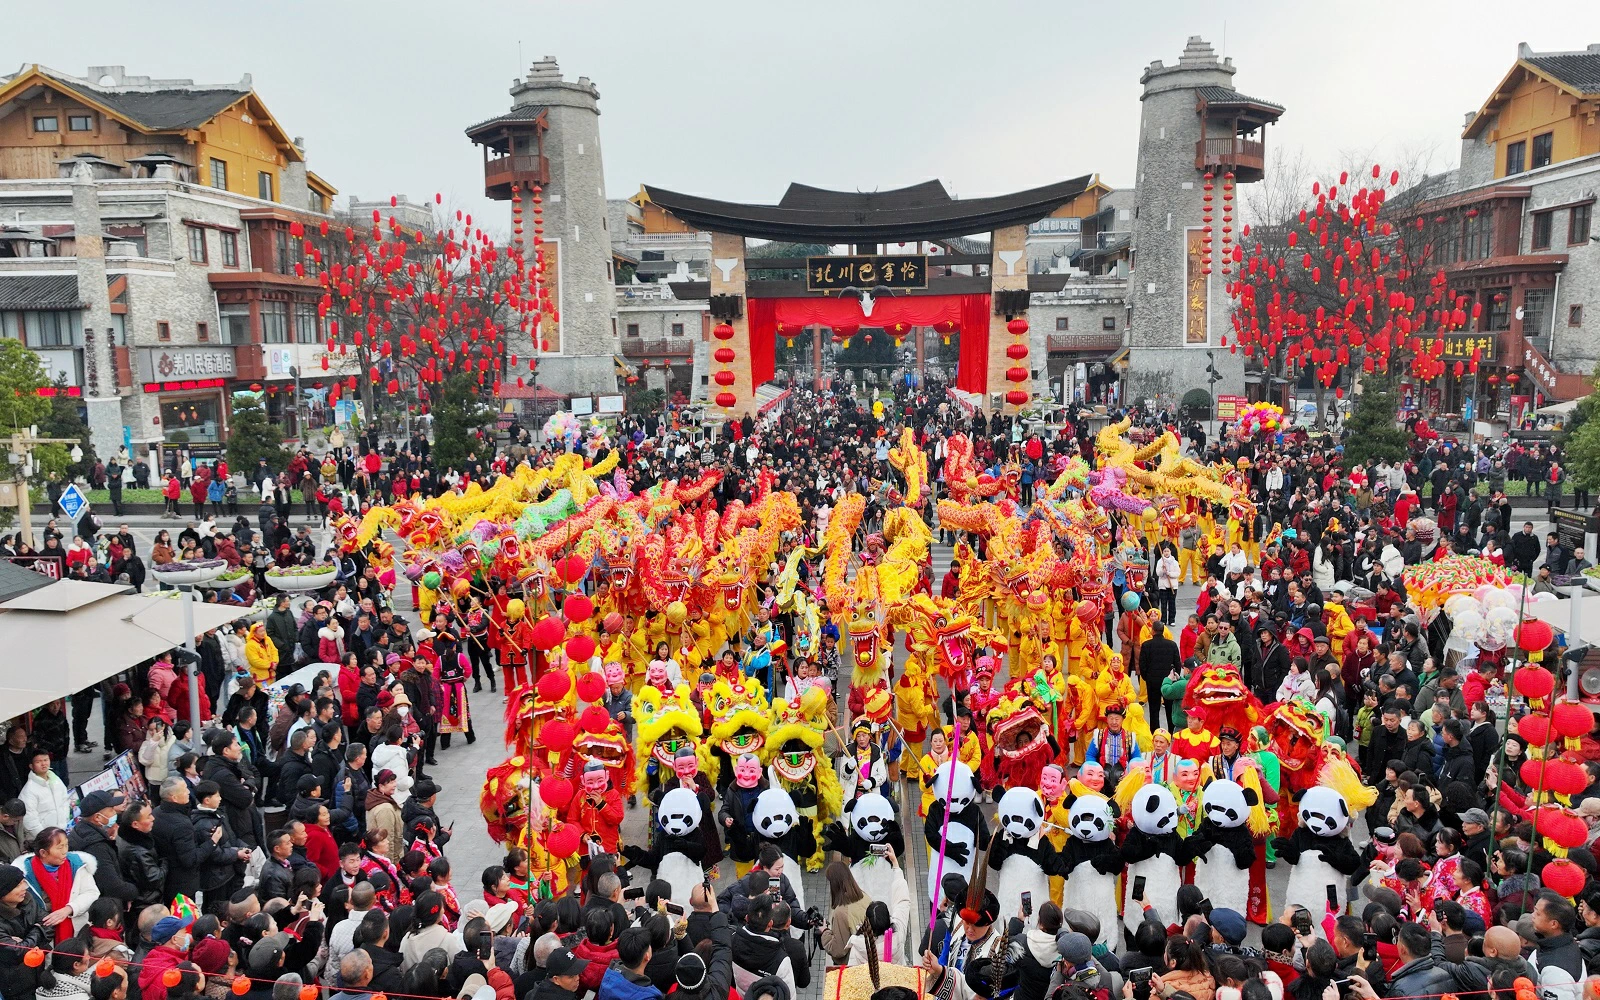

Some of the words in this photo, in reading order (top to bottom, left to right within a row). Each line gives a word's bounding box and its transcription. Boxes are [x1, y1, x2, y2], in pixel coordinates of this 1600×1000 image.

[815, 261, 919, 283] 北川巴拿恰
[1419, 337, 1487, 356] 山土特产
[173, 352, 232, 375] 羌风民宿酒店
